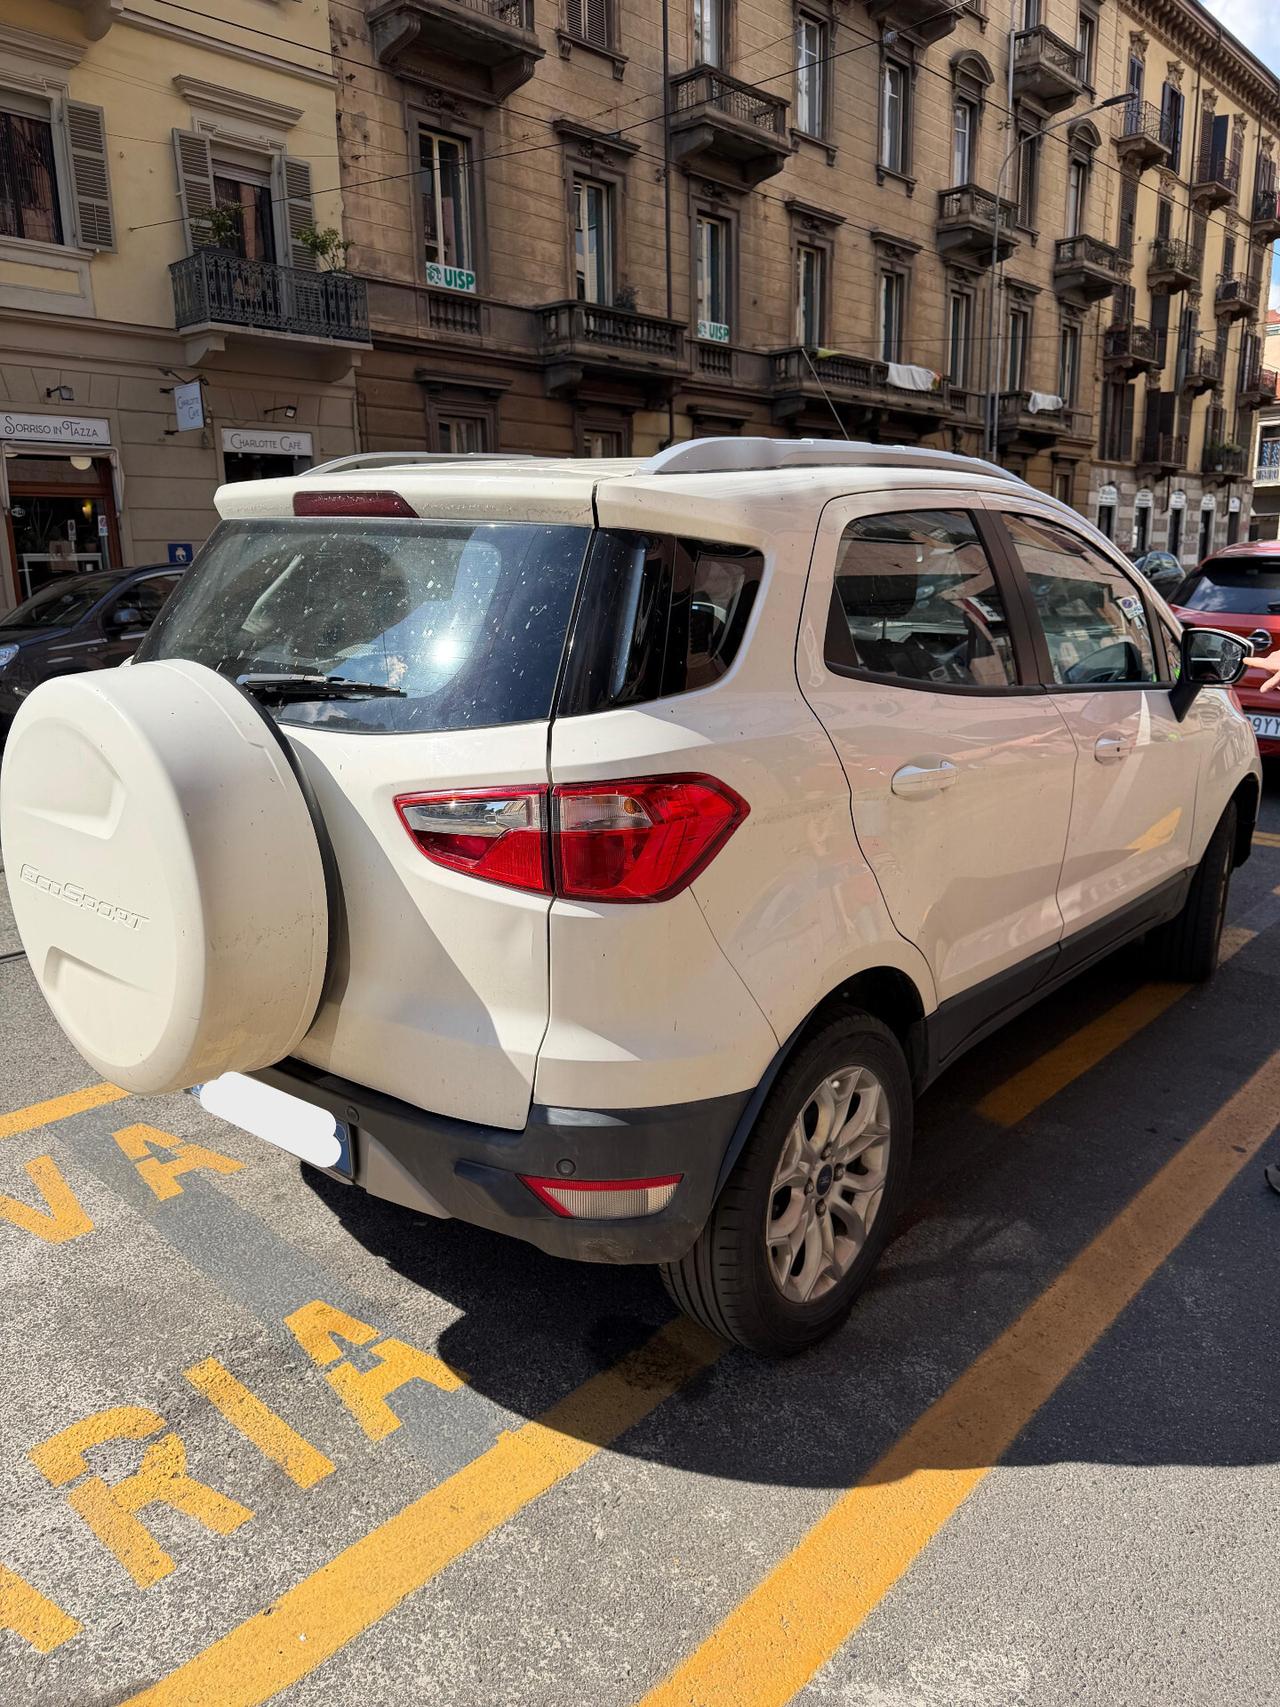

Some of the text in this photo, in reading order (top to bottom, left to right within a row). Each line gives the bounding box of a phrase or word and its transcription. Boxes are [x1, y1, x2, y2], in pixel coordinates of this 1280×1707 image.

[444, 267, 475, 290] UISP
[709, 323, 729, 341] UISP
[4, 415, 52, 435] SORRISO
[61, 420, 99, 437] TAZZA
[230, 433, 278, 449] CHARLOTTE
